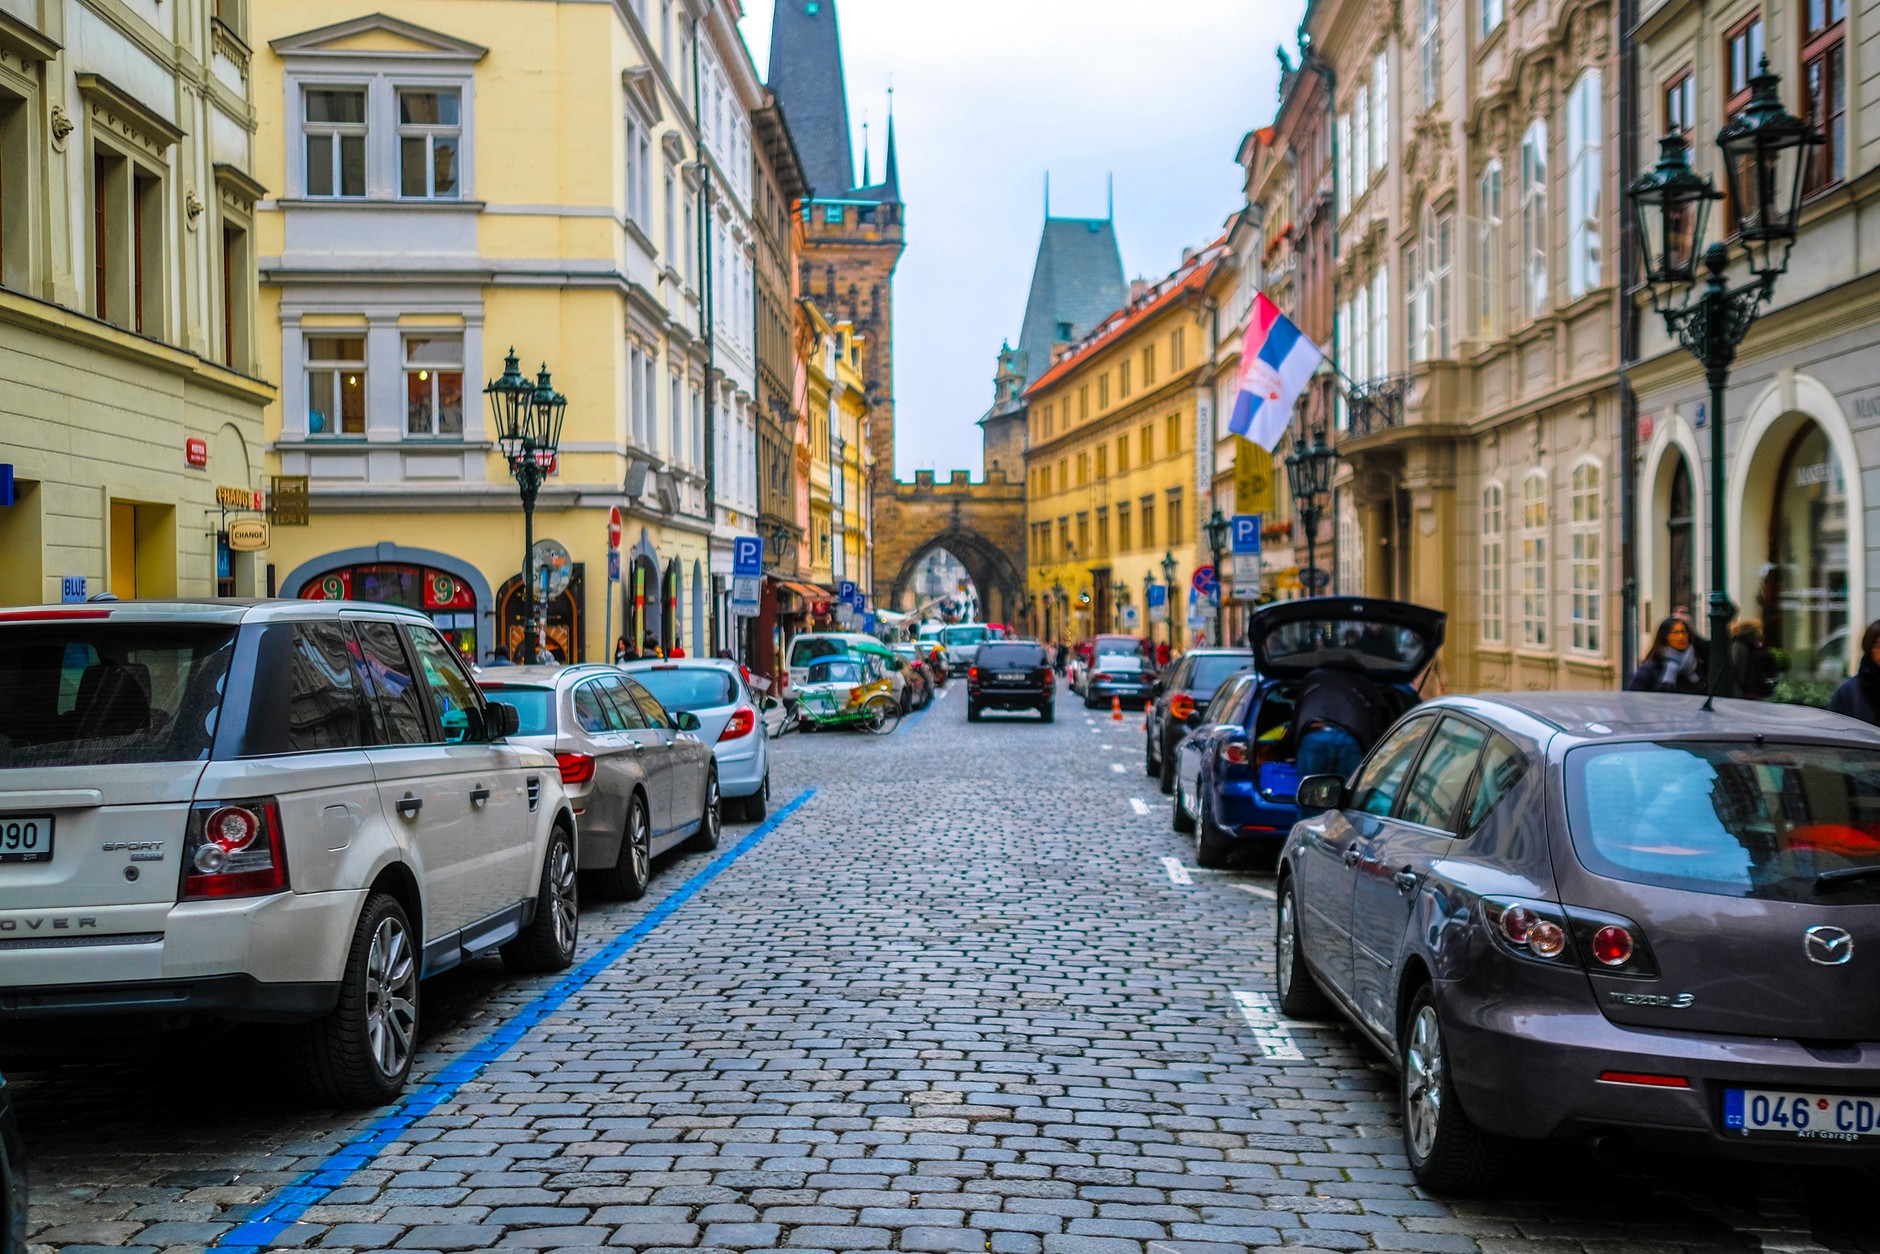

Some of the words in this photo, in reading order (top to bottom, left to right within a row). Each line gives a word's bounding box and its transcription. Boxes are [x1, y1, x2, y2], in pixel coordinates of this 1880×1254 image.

[216, 486, 254, 509] CHANGE
[234, 531, 263, 539] CHANGE
[1238, 520, 1254, 541] P
[740, 542, 757, 564] P
[64, 578, 86, 596] BLUE
[322, 574, 345, 600] 9
[433, 575, 454, 605] 9
[842, 583, 853, 597] P
[0, 822, 38, 850] 90
[102, 840, 165, 852] SPORT
[0, 916, 97, 931] OVER
[1727, 1115, 1743, 1125] CZ
[1751, 1095, 1810, 1129] 046
[1836, 1100, 1880, 1133] CD
[1798, 1129, 1816, 1139] Art
[1819, 1130, 1860, 1142] Garage
